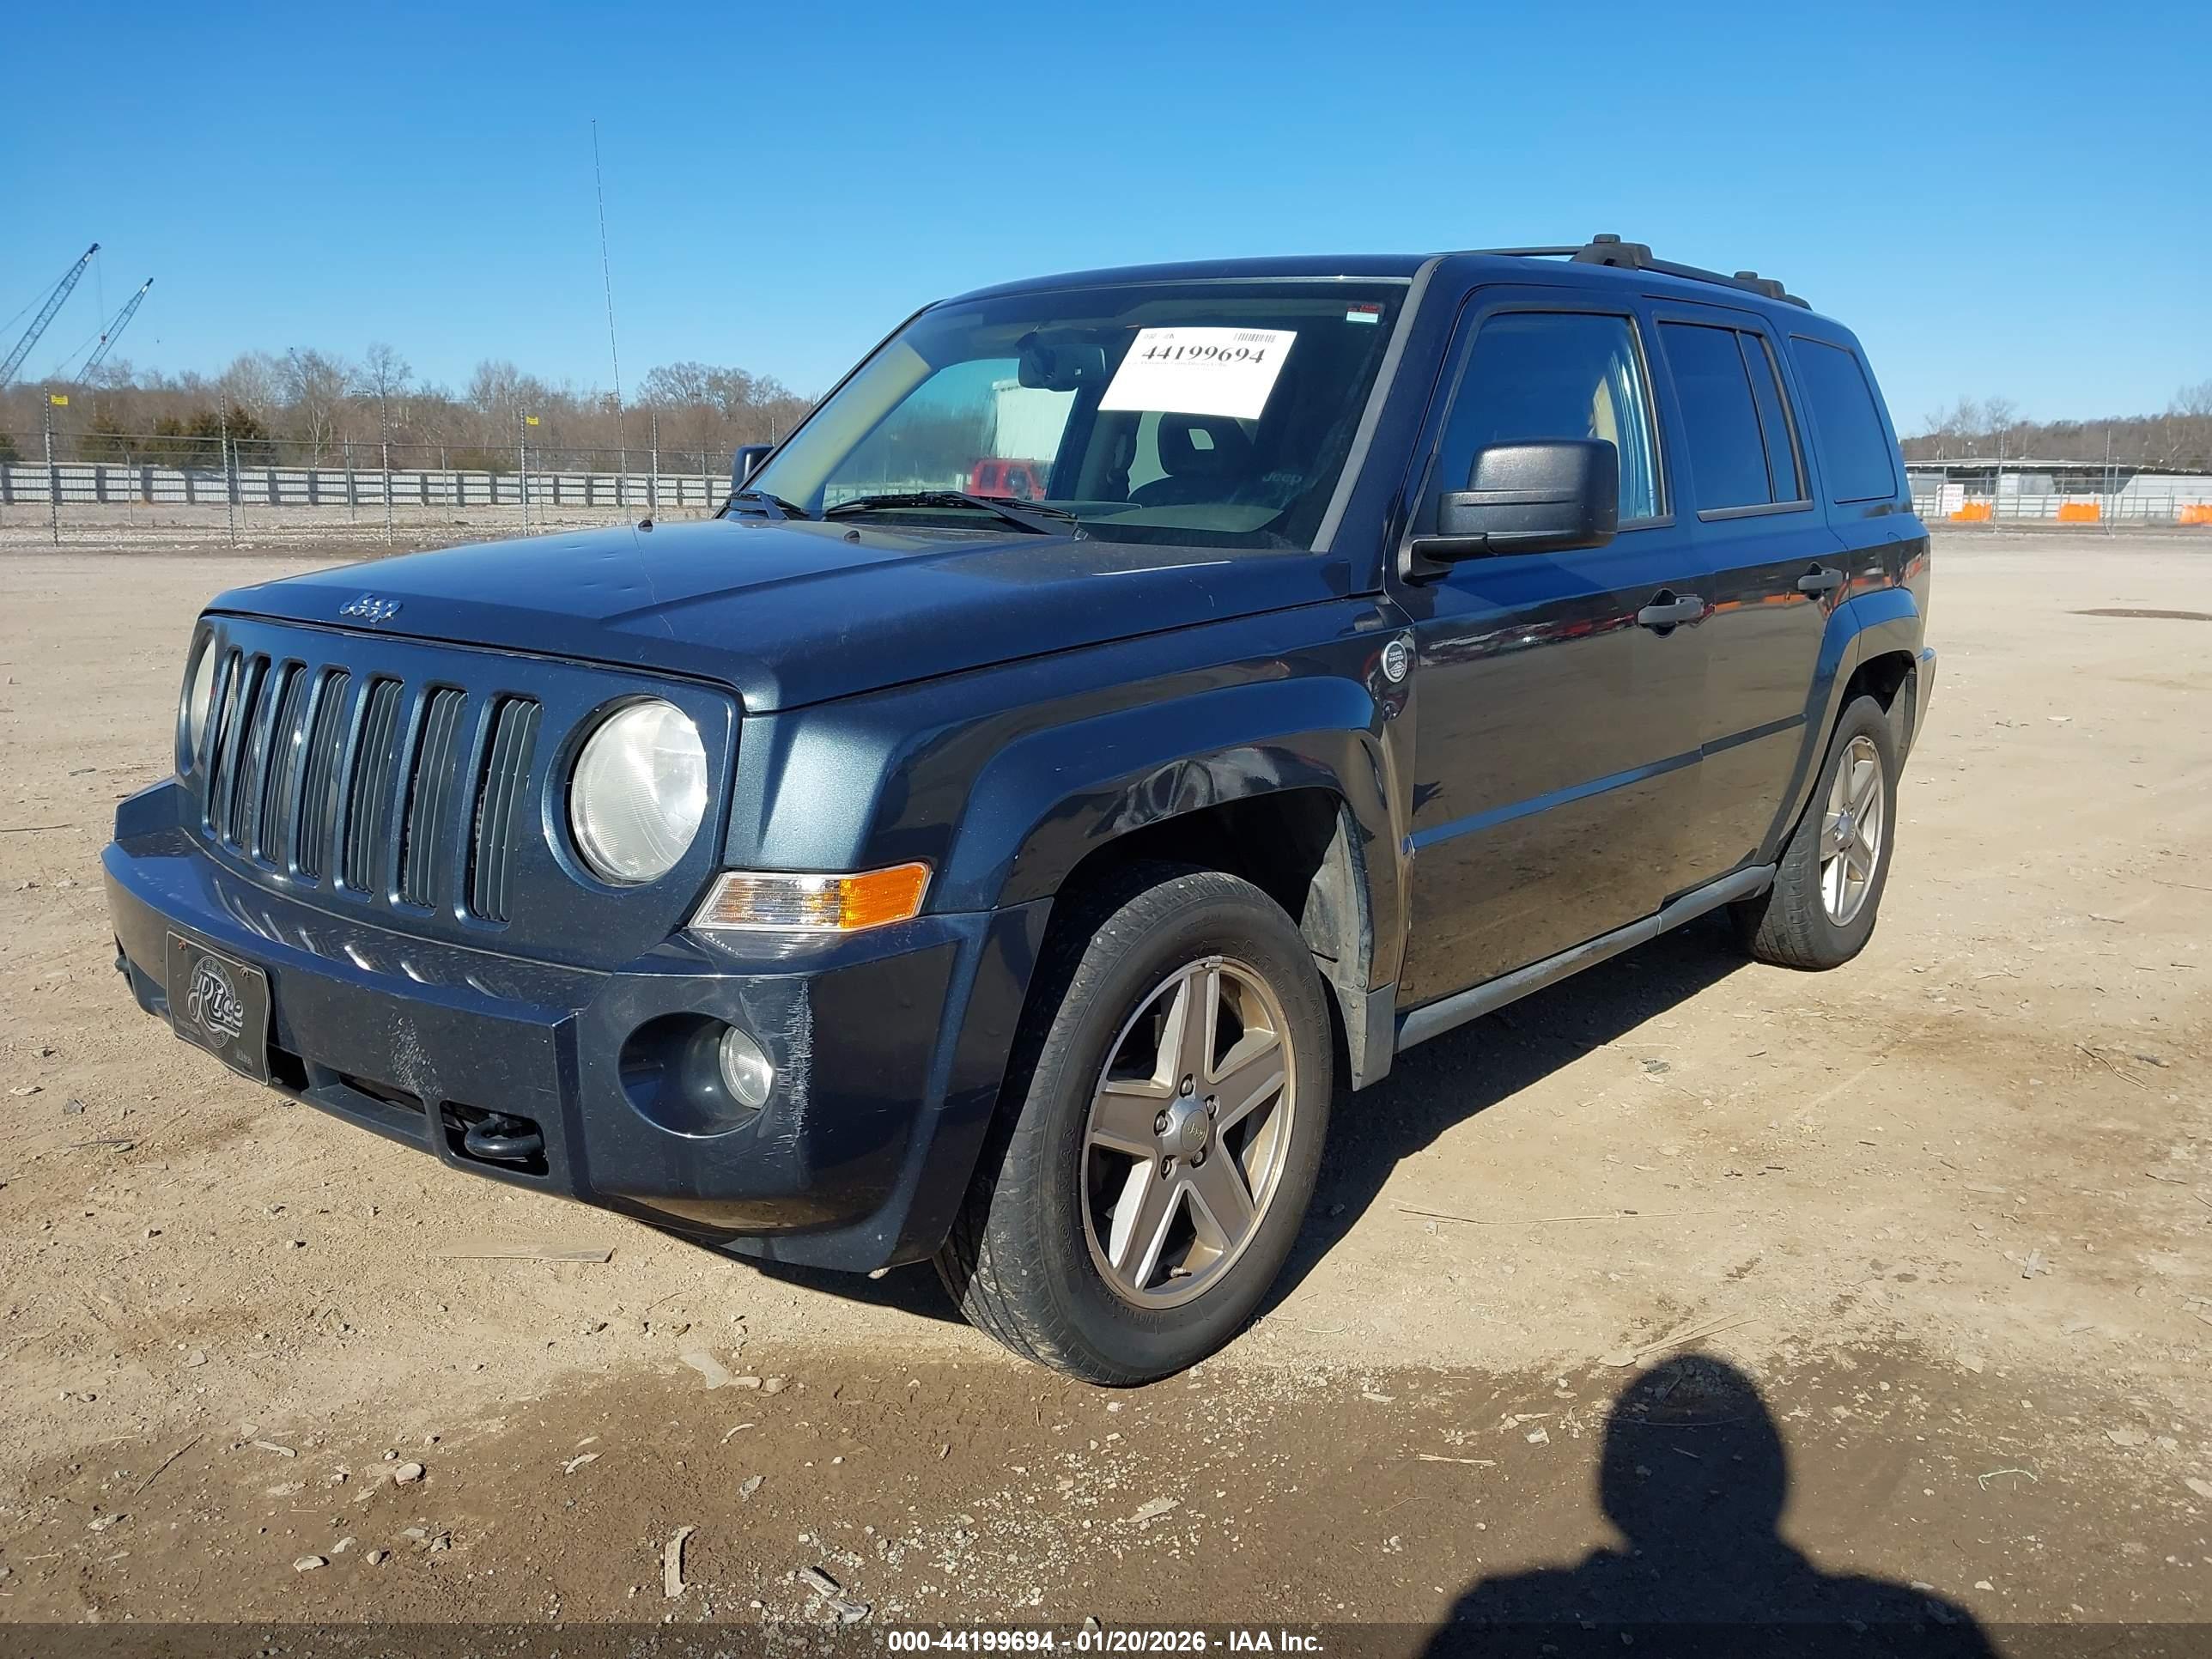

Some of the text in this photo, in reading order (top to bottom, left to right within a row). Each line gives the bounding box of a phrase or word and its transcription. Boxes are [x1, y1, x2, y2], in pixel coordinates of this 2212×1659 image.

[1141, 345, 1266, 363] 44199694
[339, 592, 402, 623] Jeep
[186, 969, 244, 1039] Rice
[1058, 1120, 1079, 1272] IRONMAN
